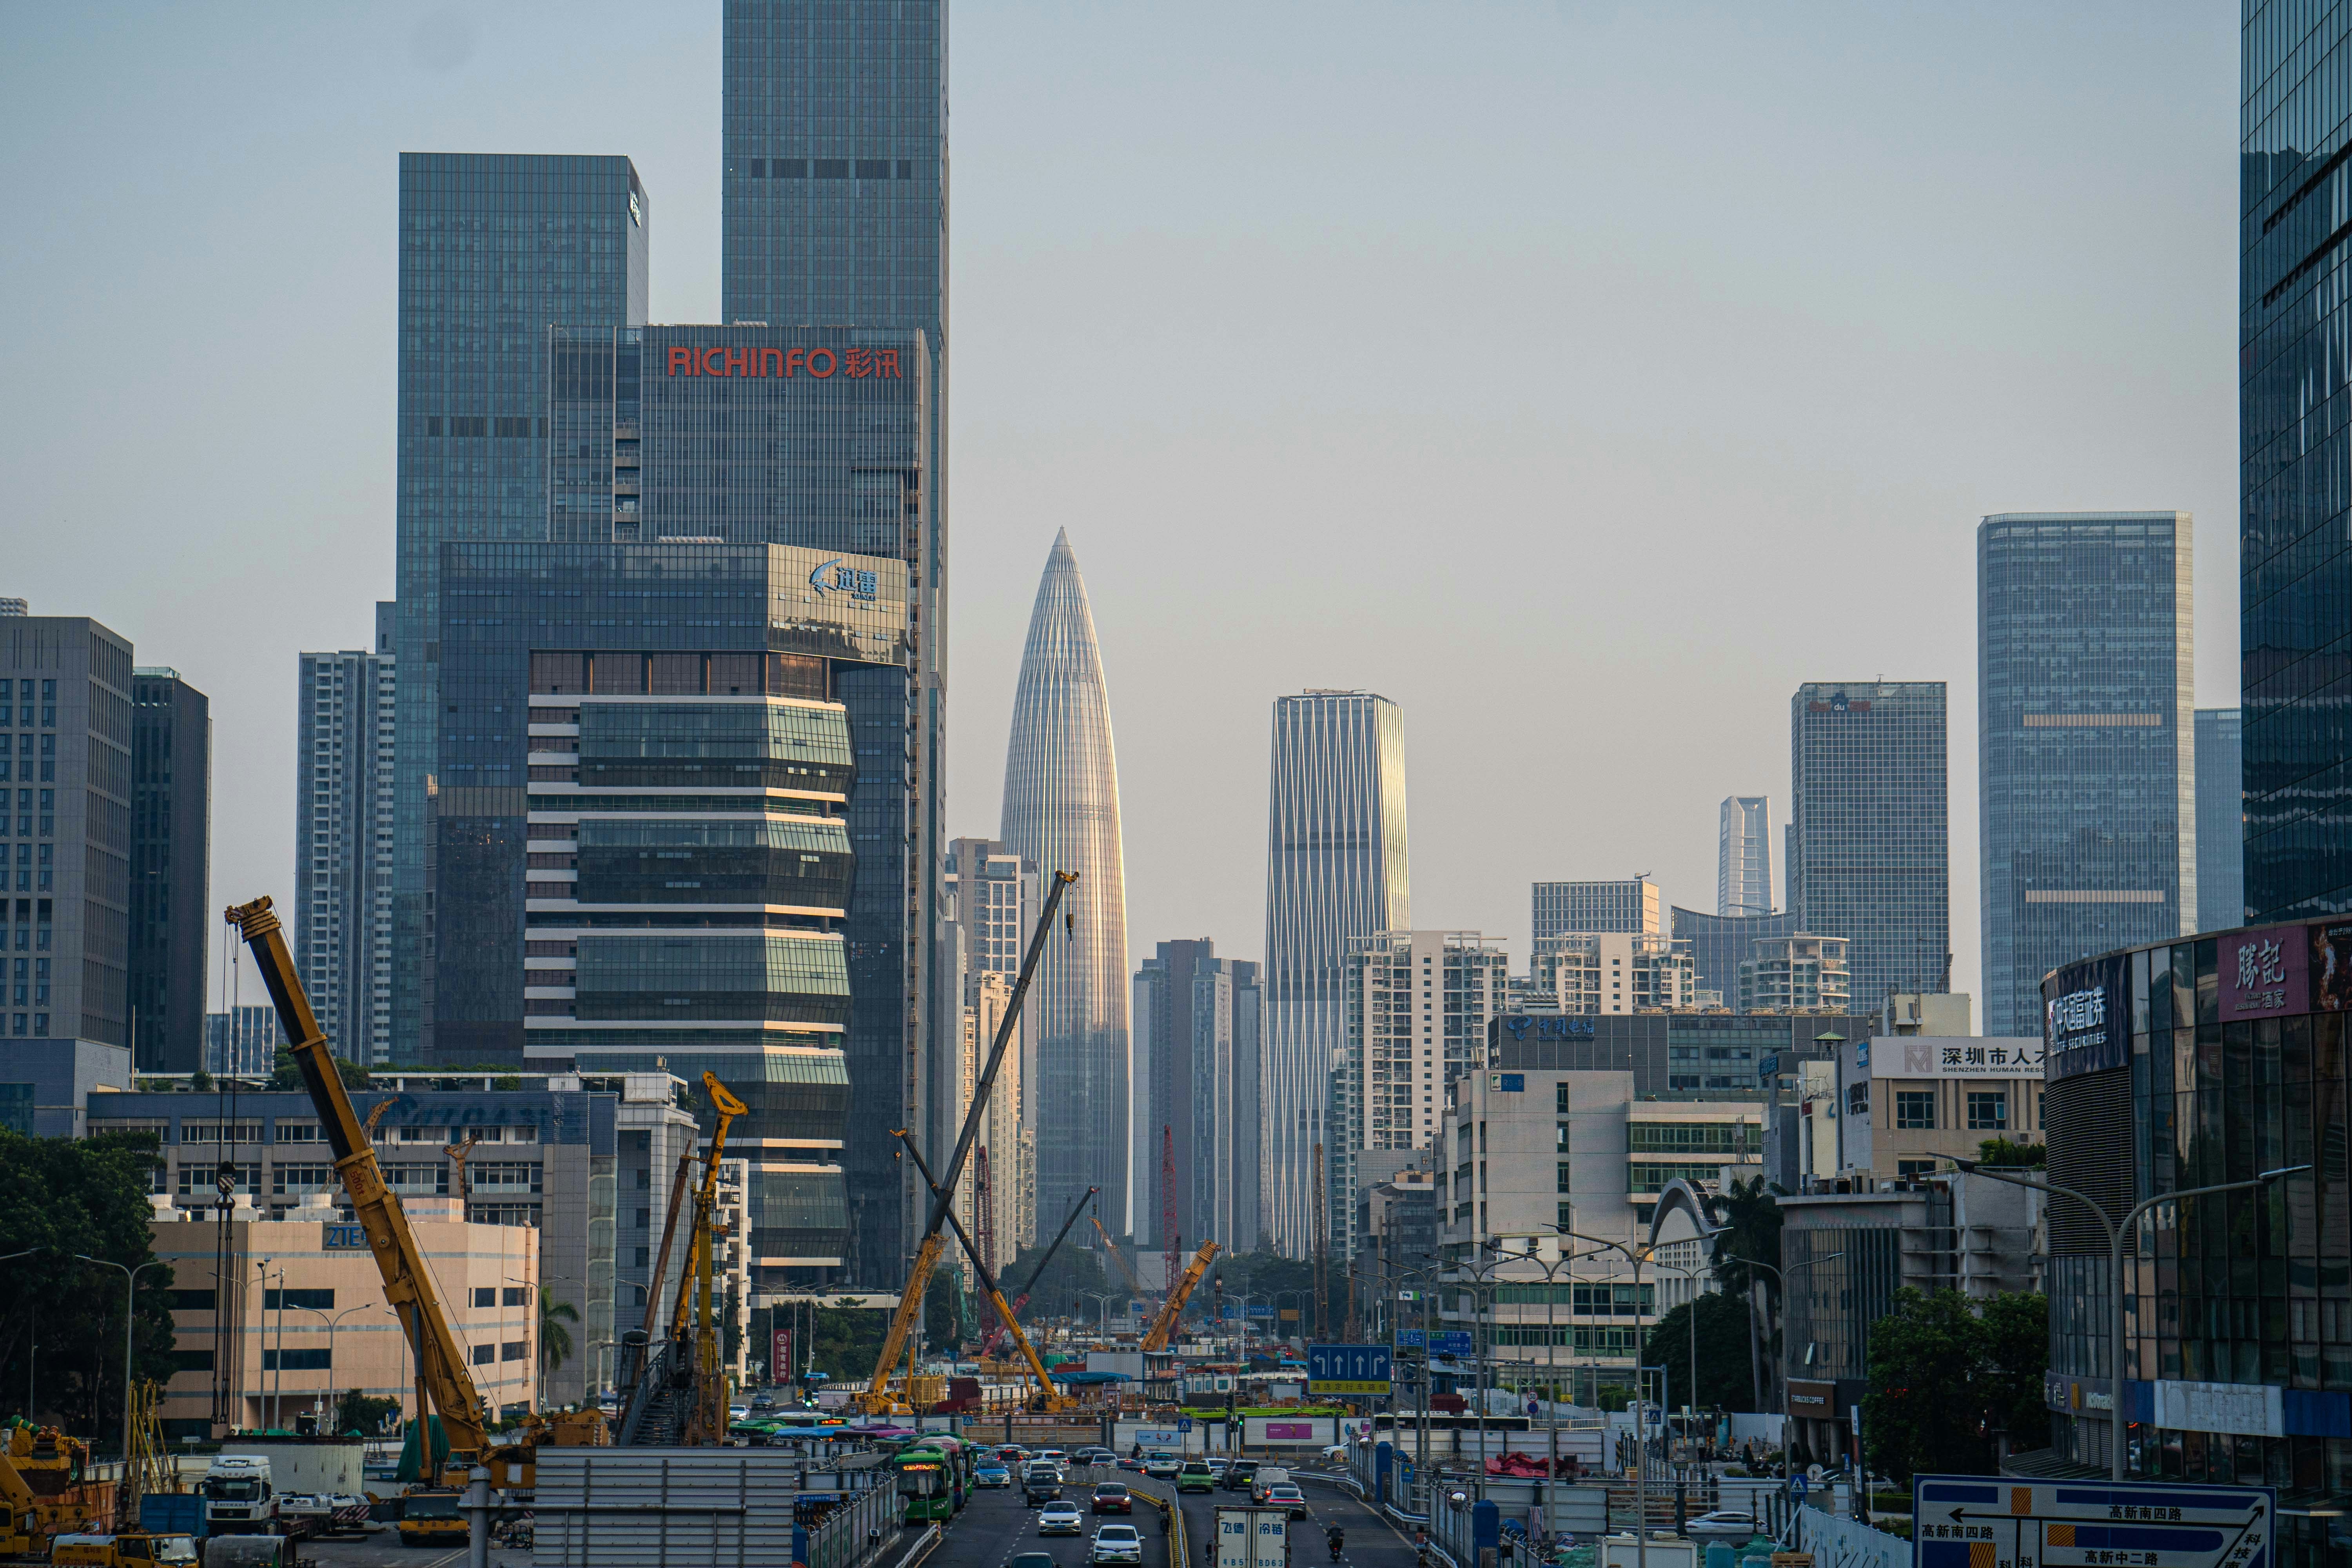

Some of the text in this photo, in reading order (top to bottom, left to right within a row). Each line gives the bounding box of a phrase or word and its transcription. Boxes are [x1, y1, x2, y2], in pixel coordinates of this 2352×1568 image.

[668, 347, 902, 379] RICHINFO 彩讯
[837, 567, 877, 593] 迅雷
[2262, 989, 2285, 1009] 酒家
[2057, 986, 2105, 1035] 中天国富证券
[1538, 1018, 1594, 1035] 中国电信
[327, 1226, 360, 1246] ZTE
[1791, 1395, 1809, 1403] STARBUCKS
[2109, 1505, 2182, 1521] 高新南四路
[1221, 1522, 1283, 1535] 飞德 冷链
[1922, 1524, 1994, 1539] 高新南四路
[2085, 1550, 2158, 1566] 高新中二路
